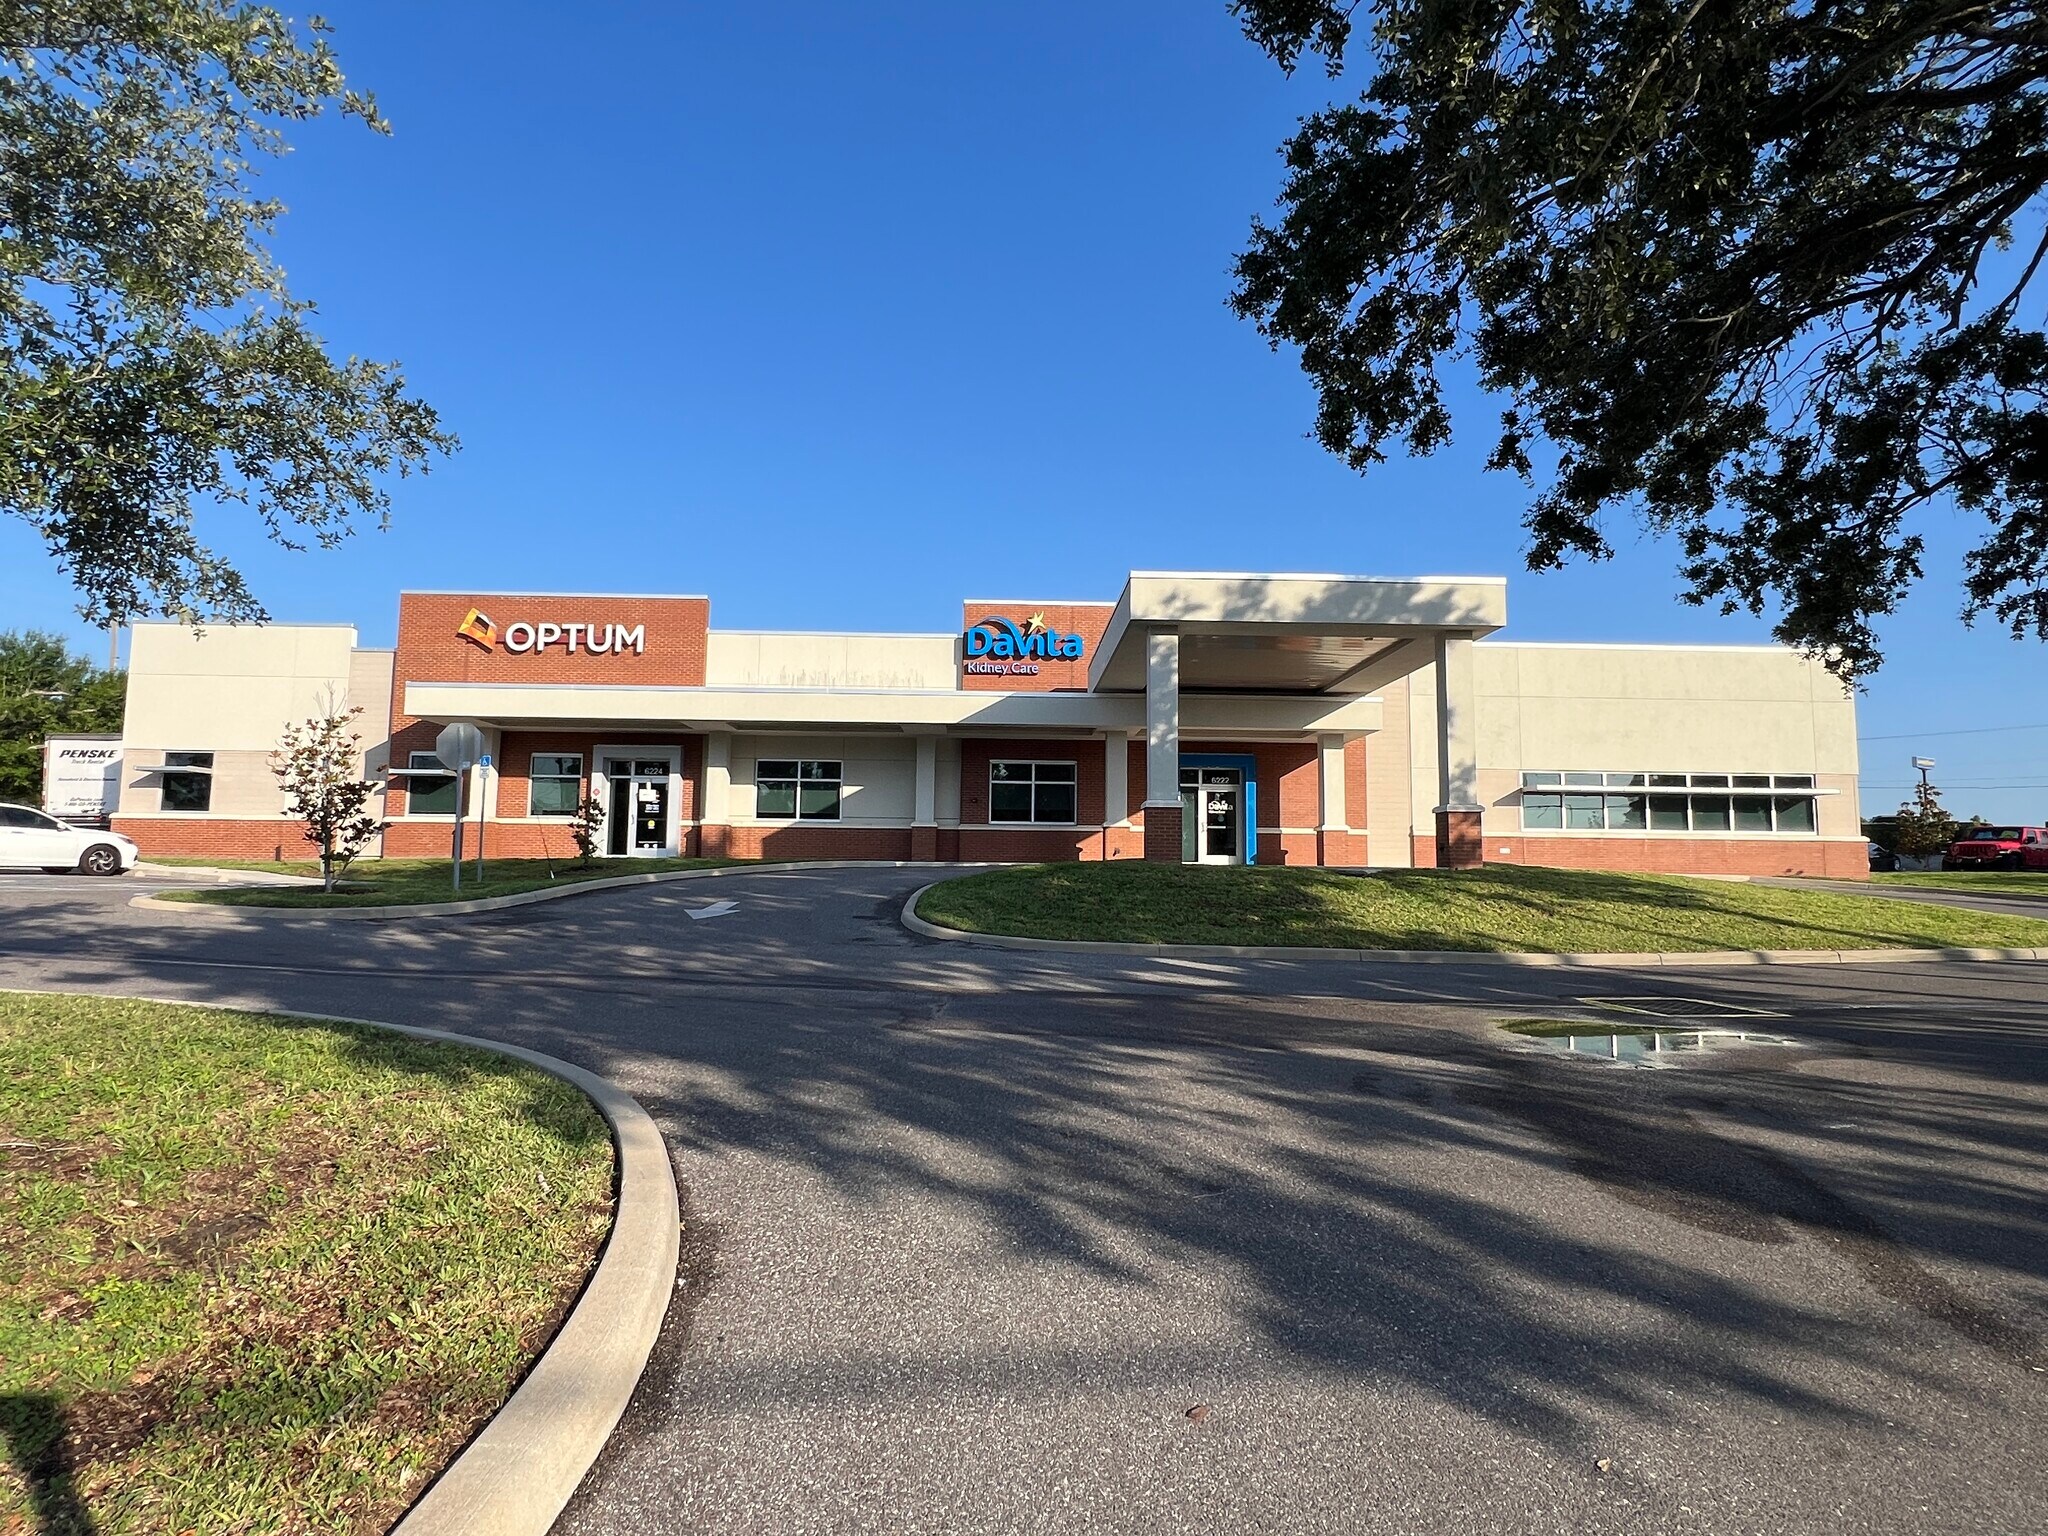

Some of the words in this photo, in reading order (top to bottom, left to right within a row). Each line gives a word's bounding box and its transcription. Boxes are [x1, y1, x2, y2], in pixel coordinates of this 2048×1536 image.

[505, 622, 645, 653] OPTUM
[966, 615, 1084, 657] DaVita
[967, 662, 1009, 675] Kidney
[1011, 662, 1039, 674] Care
[59, 749, 118, 758] PENSKE
[644, 767, 663, 775] 6224
[1208, 800, 1233, 811] DaVita
